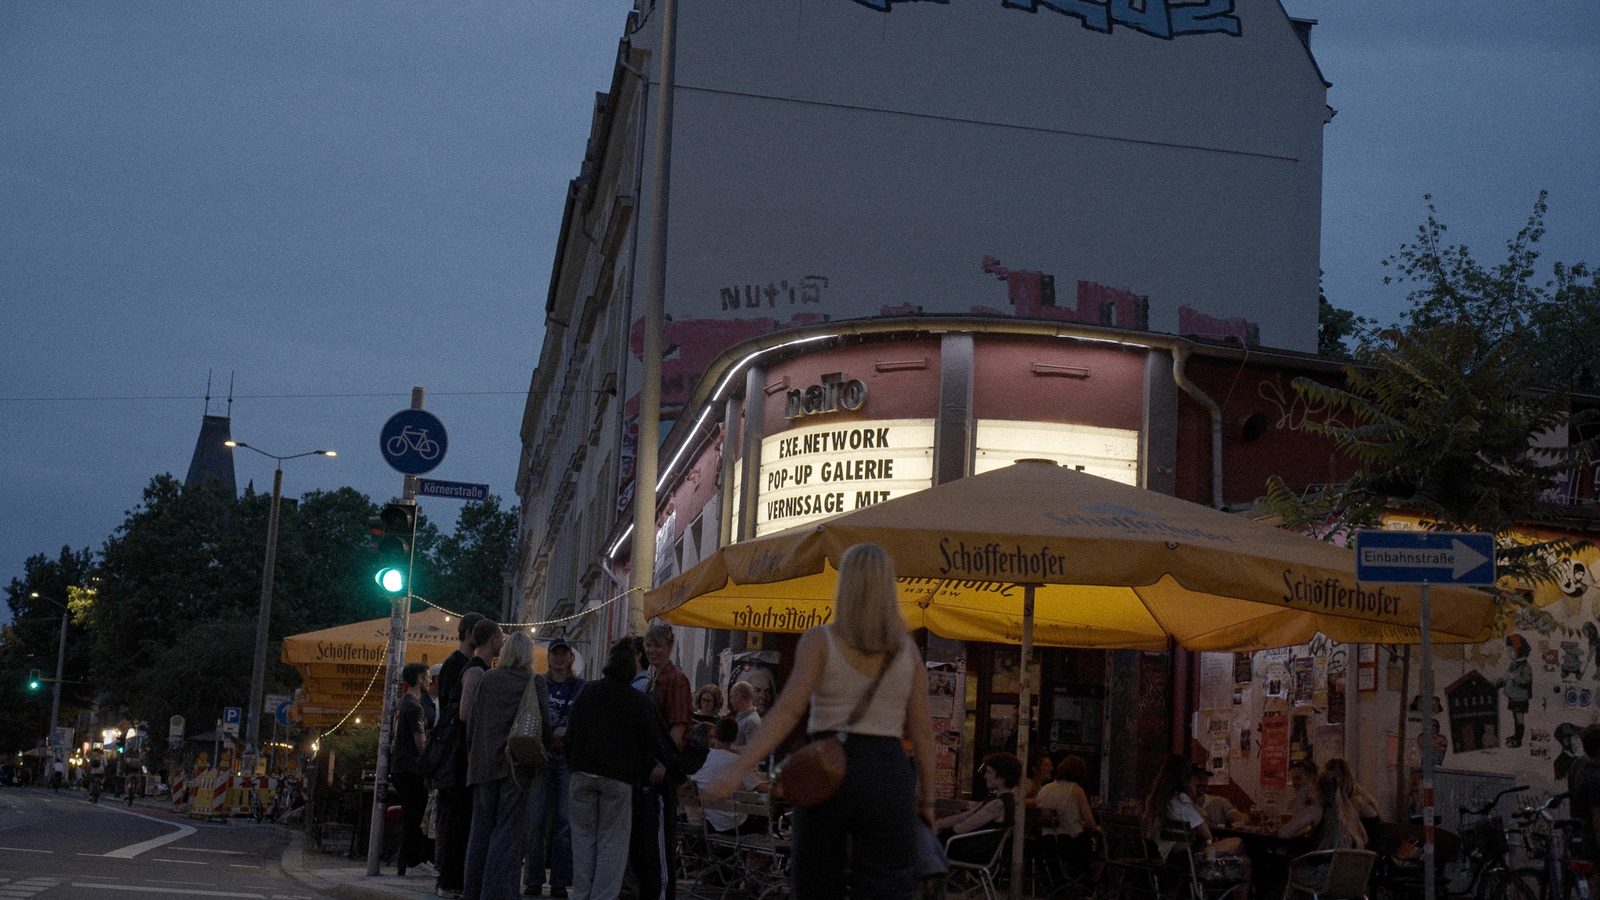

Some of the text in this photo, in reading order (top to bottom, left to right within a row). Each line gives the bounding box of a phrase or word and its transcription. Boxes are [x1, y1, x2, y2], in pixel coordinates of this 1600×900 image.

[778, 427, 890, 460] EXE.NETWORK
[423, 481, 483, 498] Körnerstraße
[767, 458, 894, 492] POP-UP GALERIE
[767, 492, 844, 521] VERNISSAGE
[939, 536, 1066, 577] Schöfferhofer
[1364, 550, 1455, 565] Einbahnstraße
[1282, 568, 1401, 616] Schöfferhofer
[227, 709, 237, 722] P
